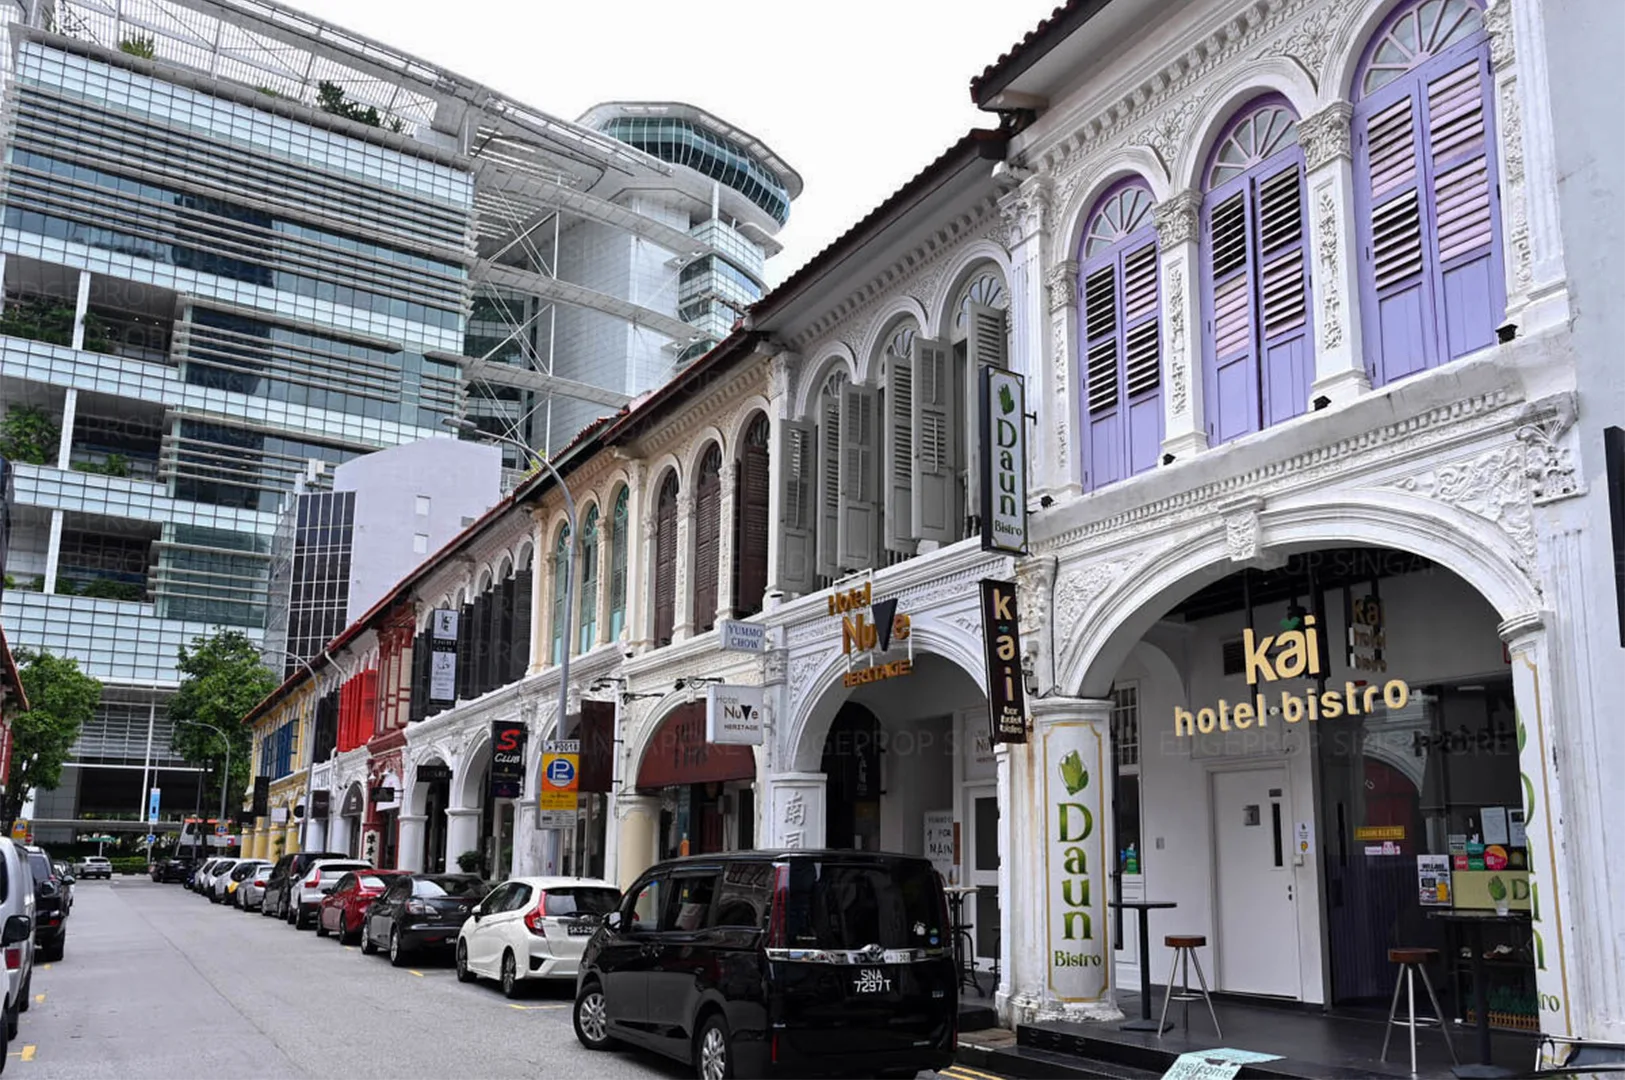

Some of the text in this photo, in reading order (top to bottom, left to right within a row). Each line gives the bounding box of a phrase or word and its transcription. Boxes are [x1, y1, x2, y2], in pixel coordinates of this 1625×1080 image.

[996, 417, 1018, 517] Daun
[994, 519, 1022, 536] Bistro
[828, 580, 871, 616] Hotel
[728, 625, 763, 638] YUMMO
[731, 637, 759, 649] CHOW
[1242, 615, 1320, 685] kai
[844, 659, 912, 688] HERITAGE
[716, 695, 739, 705] Hotel
[497, 730, 521, 751] S
[1057, 802, 1093, 940] Daun
[1054, 950, 1101, 967] Bistro
[860, 969, 883, 981] SNA
[853, 979, 892, 993] 7297T
